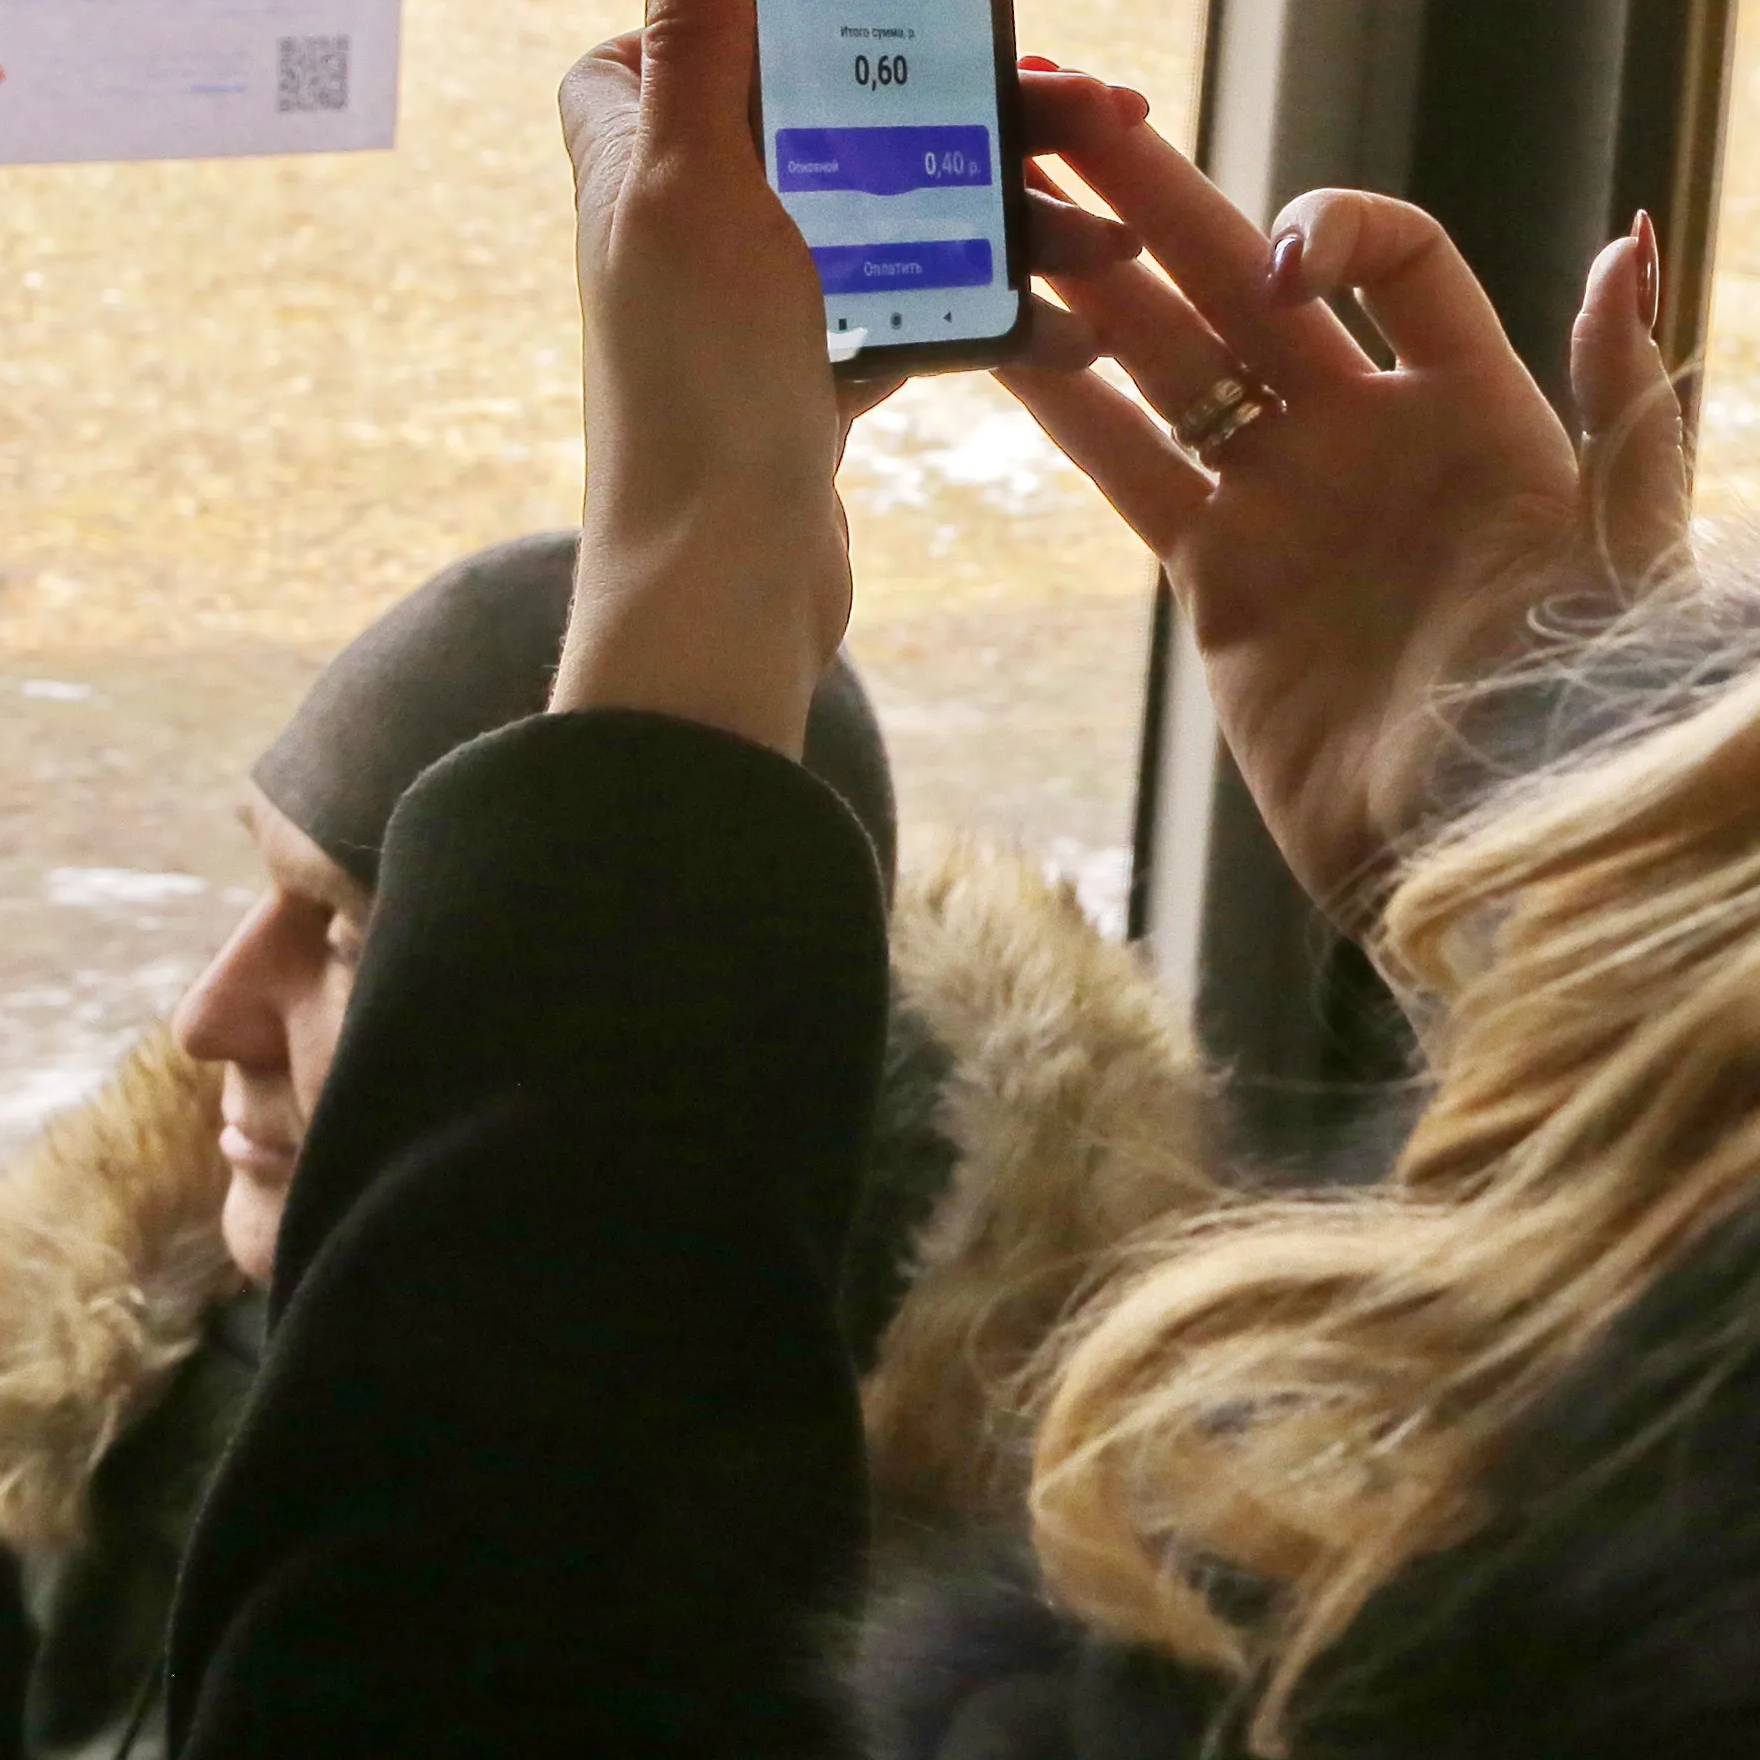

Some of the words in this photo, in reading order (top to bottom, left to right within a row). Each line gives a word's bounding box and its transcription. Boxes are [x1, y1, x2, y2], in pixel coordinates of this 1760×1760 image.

[840, 24, 870, 38] Итого
[854, 54, 908, 92] 0,60
[924, 150, 965, 179] 0,40
[863, 260, 923, 277] Оплатить
